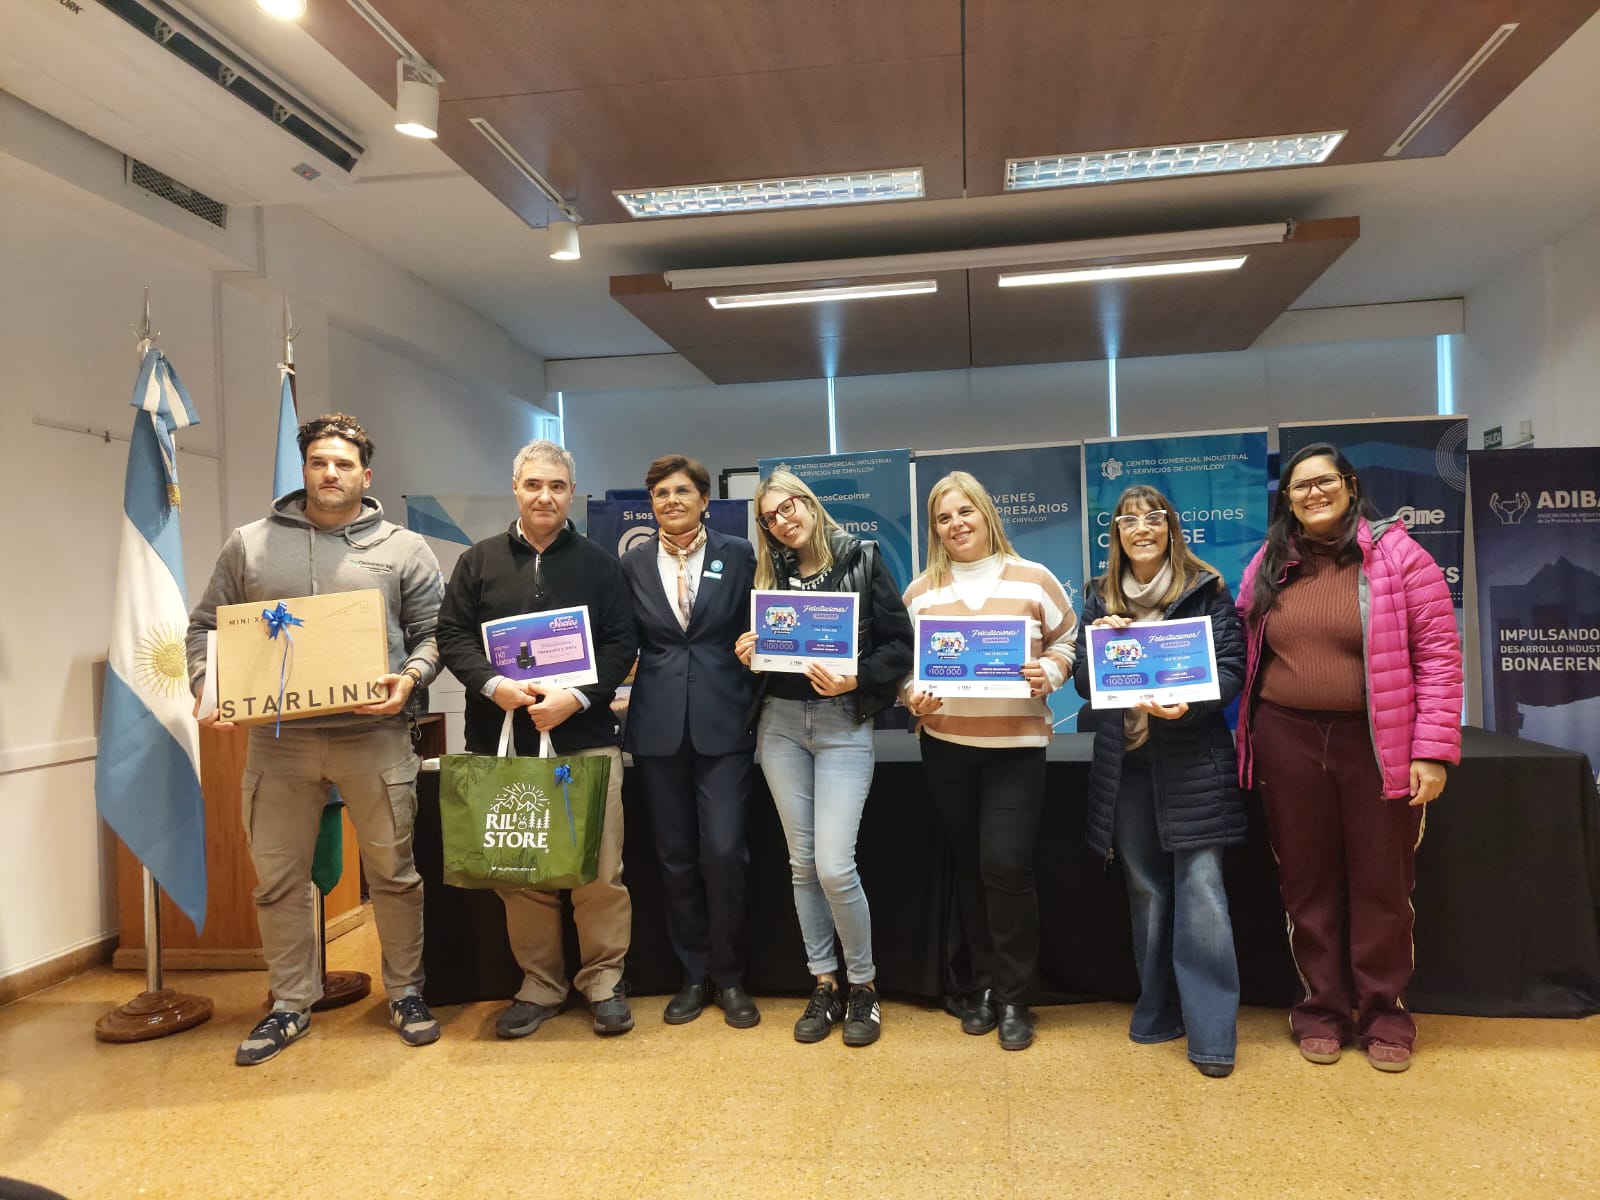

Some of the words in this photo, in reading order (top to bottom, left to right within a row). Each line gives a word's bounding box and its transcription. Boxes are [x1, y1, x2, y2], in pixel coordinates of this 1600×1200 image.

[59, 0, 84, 15] ORK
[1125, 459, 1156, 467] CENTRO
[1157, 457, 1201, 465] COMERCIAL
[1203, 453, 1249, 462] INDUSTRIAL
[800, 469, 831, 477] SERVICIOS
[842, 466, 874, 475] CHIVILCOY
[1133, 466, 1172, 475] SERVICIOS
[1173, 465, 1184, 473] DE
[1185, 463, 1225, 472] CHIVILCOY
[991, 492, 1036, 504] VENES
[1536, 490, 1600, 509] ADIB
[995, 502, 1069, 515] PRESARIOS
[623, 511, 633, 521] Si
[635, 512, 654, 520] sos
[229, 617, 250, 626] MINI
[1500, 628, 1600, 641] IMPULSANDO
[1500, 645, 1564, 653] DESARROLLO
[1566, 644, 1600, 653] INDUST
[1501, 656, 1600, 671] BONAEREN
[221, 681, 382, 719] STARLINK
[483, 831, 548, 848] STORE
